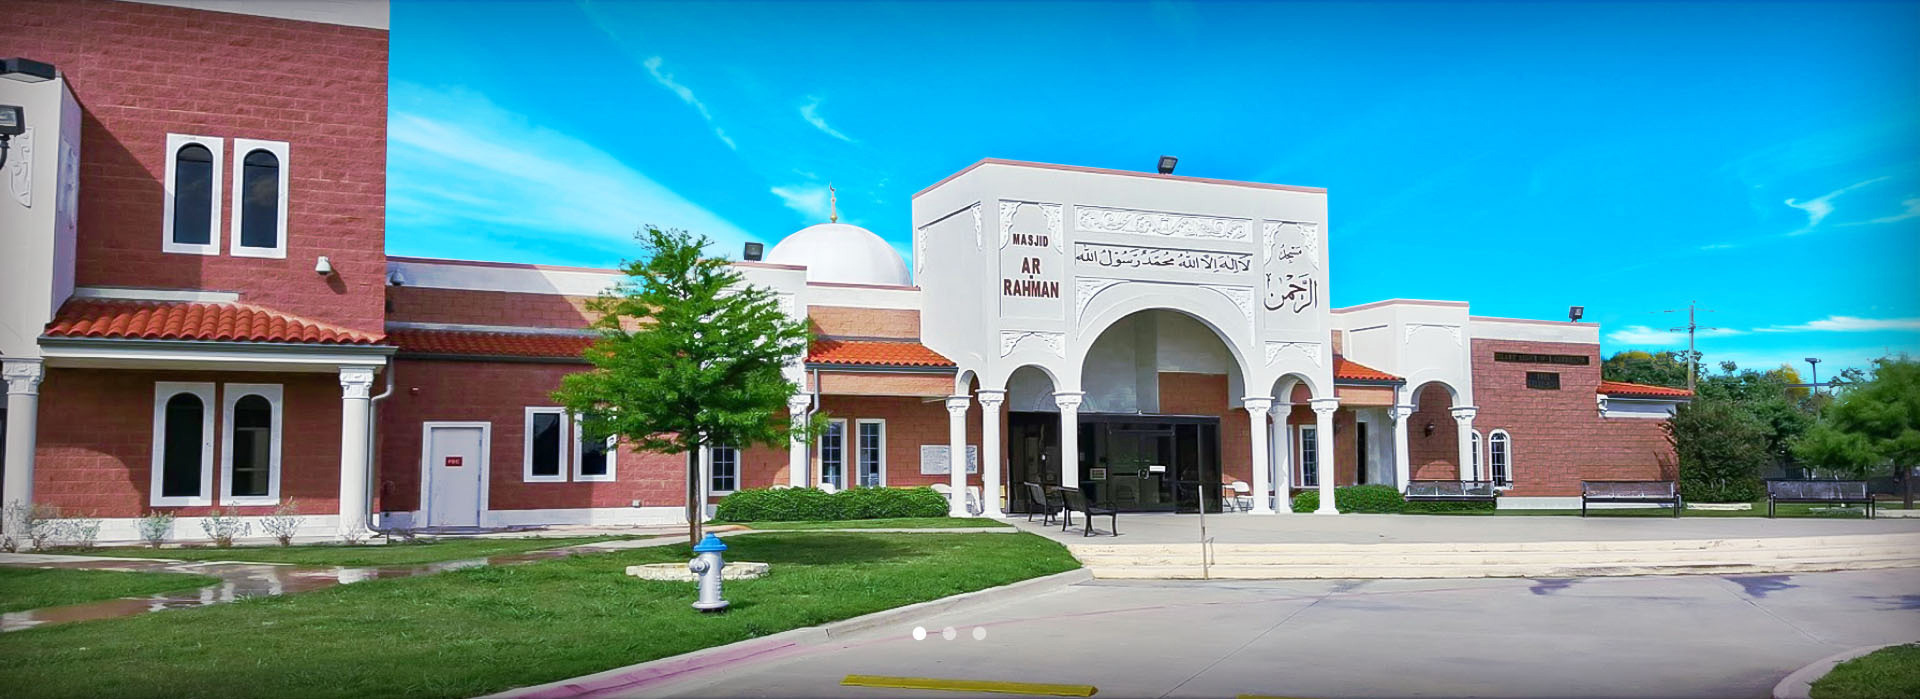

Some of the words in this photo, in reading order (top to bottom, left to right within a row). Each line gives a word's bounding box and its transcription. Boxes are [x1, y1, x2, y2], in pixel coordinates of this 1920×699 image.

[1012, 233, 1049, 247] MASJID
[1021, 256, 1041, 274] AR
[1003, 279, 1059, 298] RAHMAN
